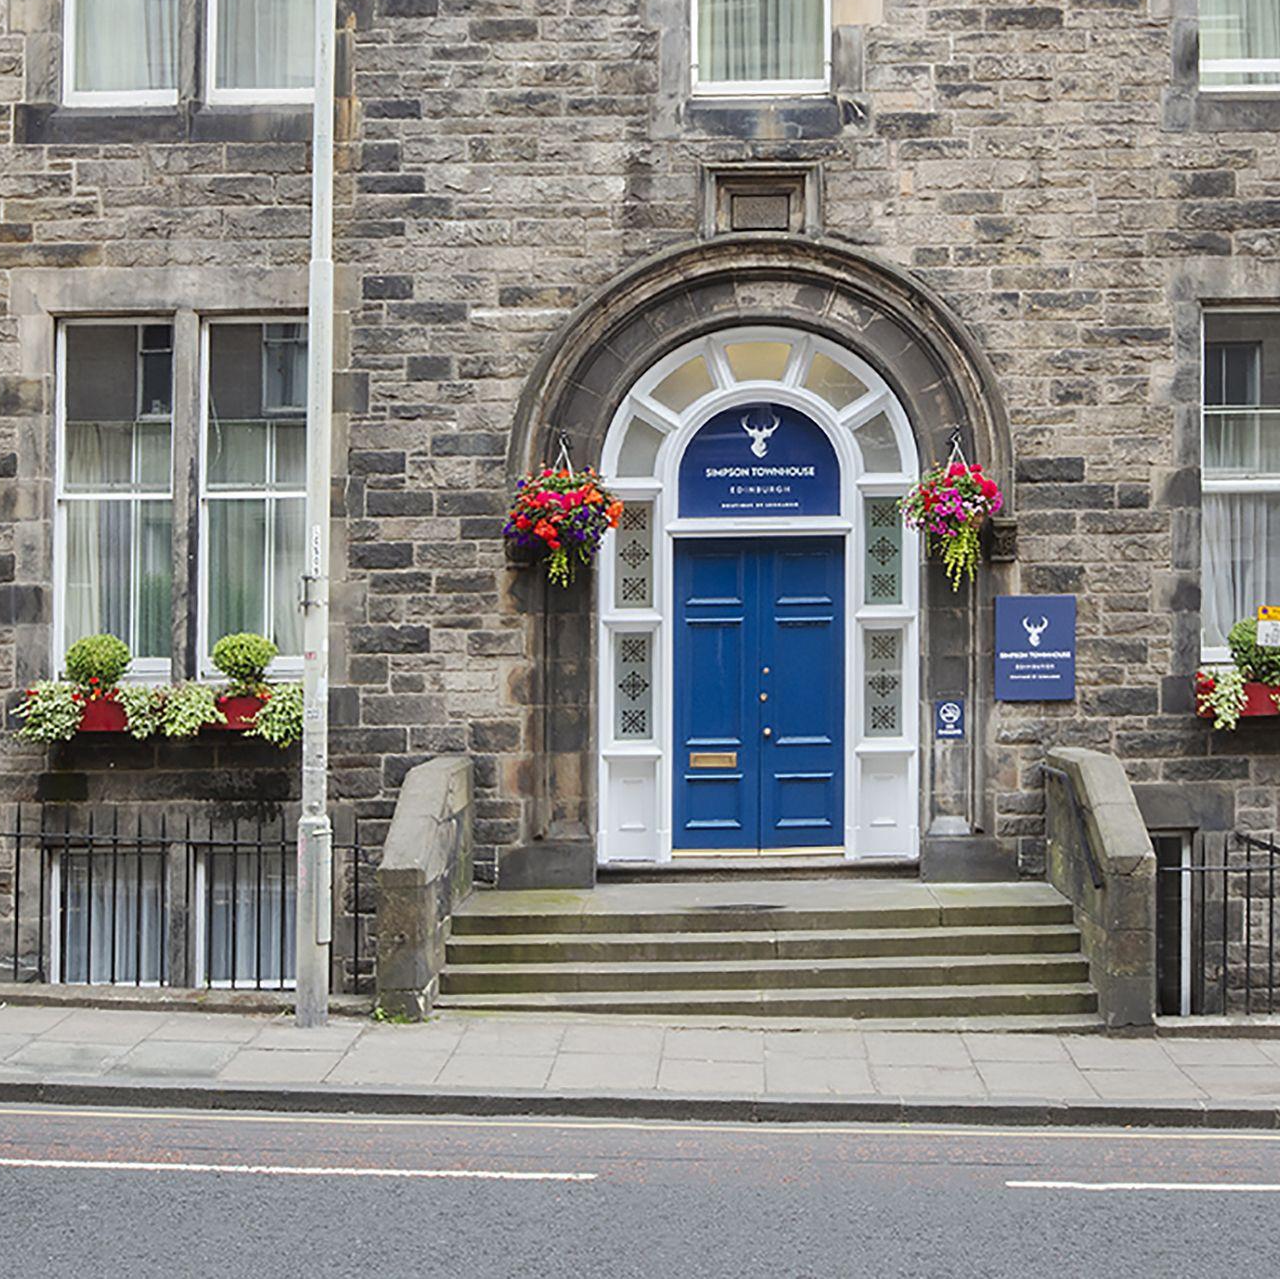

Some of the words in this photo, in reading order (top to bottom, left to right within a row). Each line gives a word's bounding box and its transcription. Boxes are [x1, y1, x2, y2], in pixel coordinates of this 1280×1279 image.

[705, 467, 750, 478] SIMPSON
[751, 466, 815, 477] TOWNHOUSE
[729, 485, 791, 494] EDINBURGH
